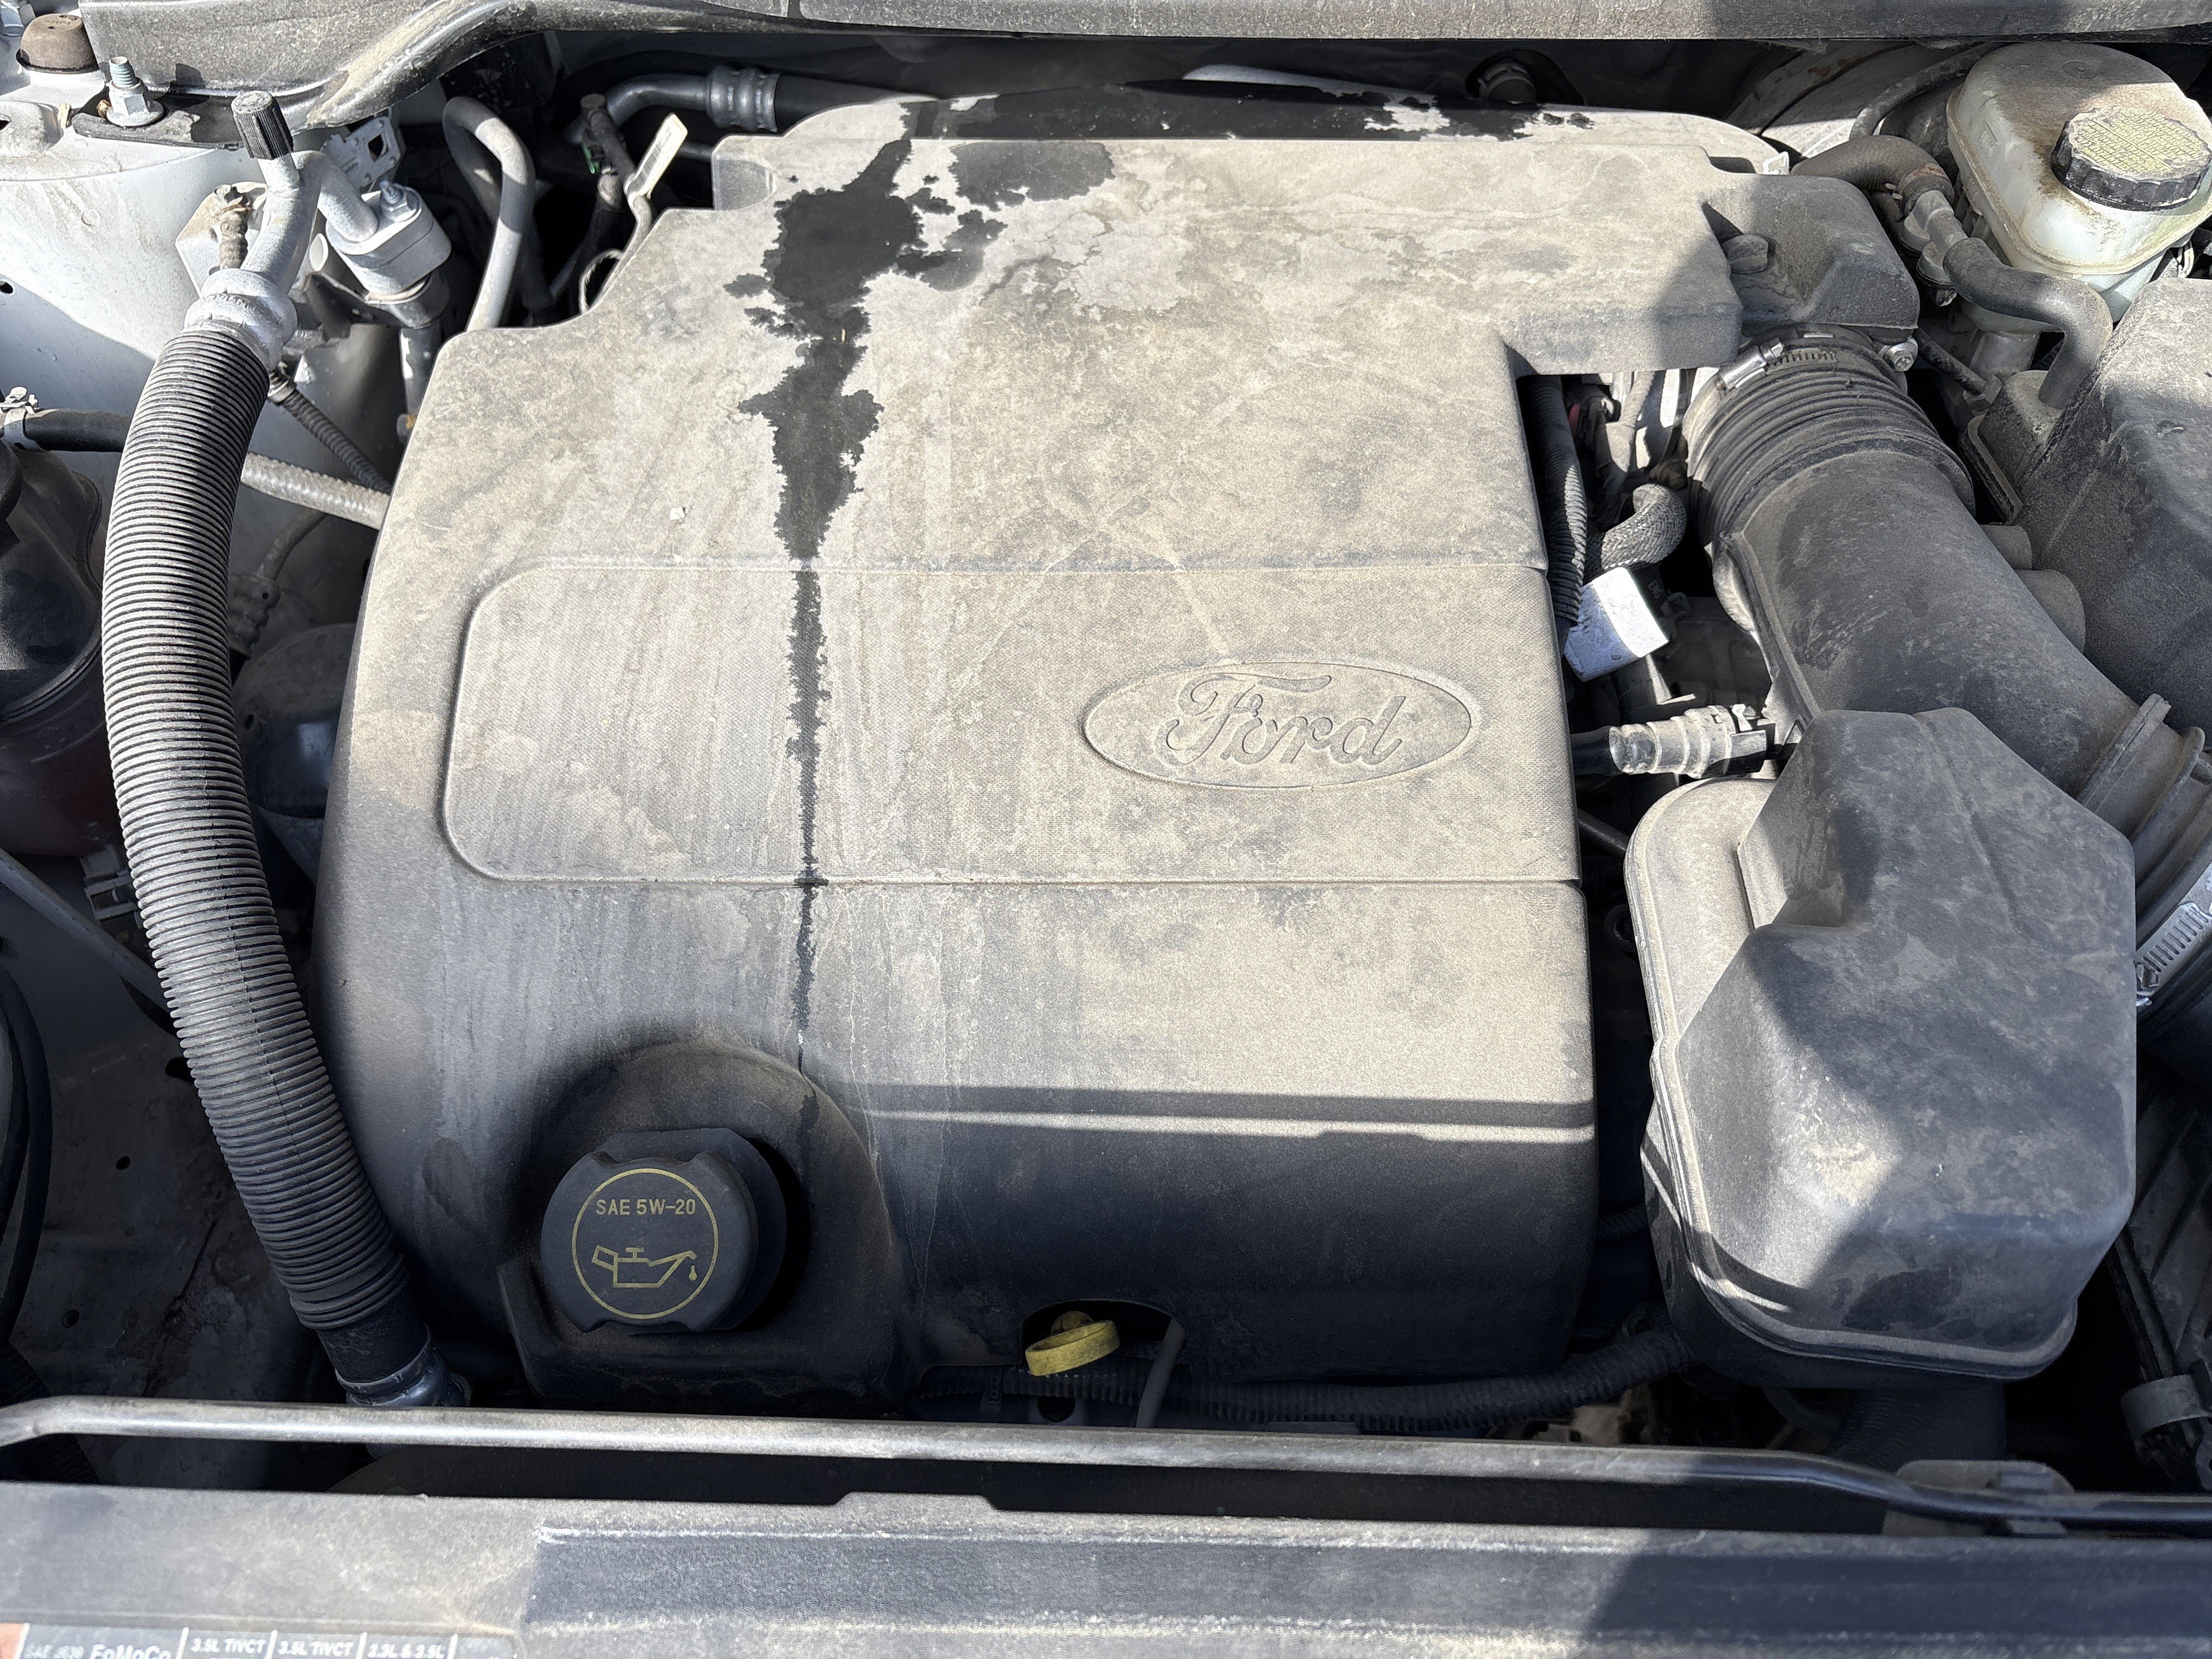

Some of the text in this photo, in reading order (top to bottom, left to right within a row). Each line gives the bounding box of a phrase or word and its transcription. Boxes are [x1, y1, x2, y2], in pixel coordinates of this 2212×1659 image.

[2075, 129, 2093, 139] USE
[2081, 125, 2102, 137] FLUID
[2109, 117, 2141, 136] BOUCHON
[2143, 116, 2184, 140] PROVENANT
[2147, 126, 2165, 136] QUE
[2096, 134, 2123, 149] BRAKE
[2110, 125, 2161, 155] AVERTISSEMENT
[2159, 140, 2186, 155] AVANT
[2183, 141, 2203, 151] DOT
[2074, 136, 2132, 171] CLEAN FILLER CAP
[2117, 140, 2145, 156] SEALED
[2143, 138, 2179, 159] NETTOYER
[2079, 146, 2112, 166] WARNING
[2117, 155, 2147, 172] BEFORE
[2123, 151, 2141, 161] DOT
[2143, 156, 2168, 170] FROM
[2134, 159, 2157, 171] ONLY
[1155, 673, 1407, 766] Ford
[595, 1198, 697, 1216] SAE 5W-20
[89, 1644, 172, 1659] FoMoCo
[190, 1637, 221, 1652] 3.5L
[277, 1640, 308, 1656] 3.5L
[400, 1643, 412, 1658] &
